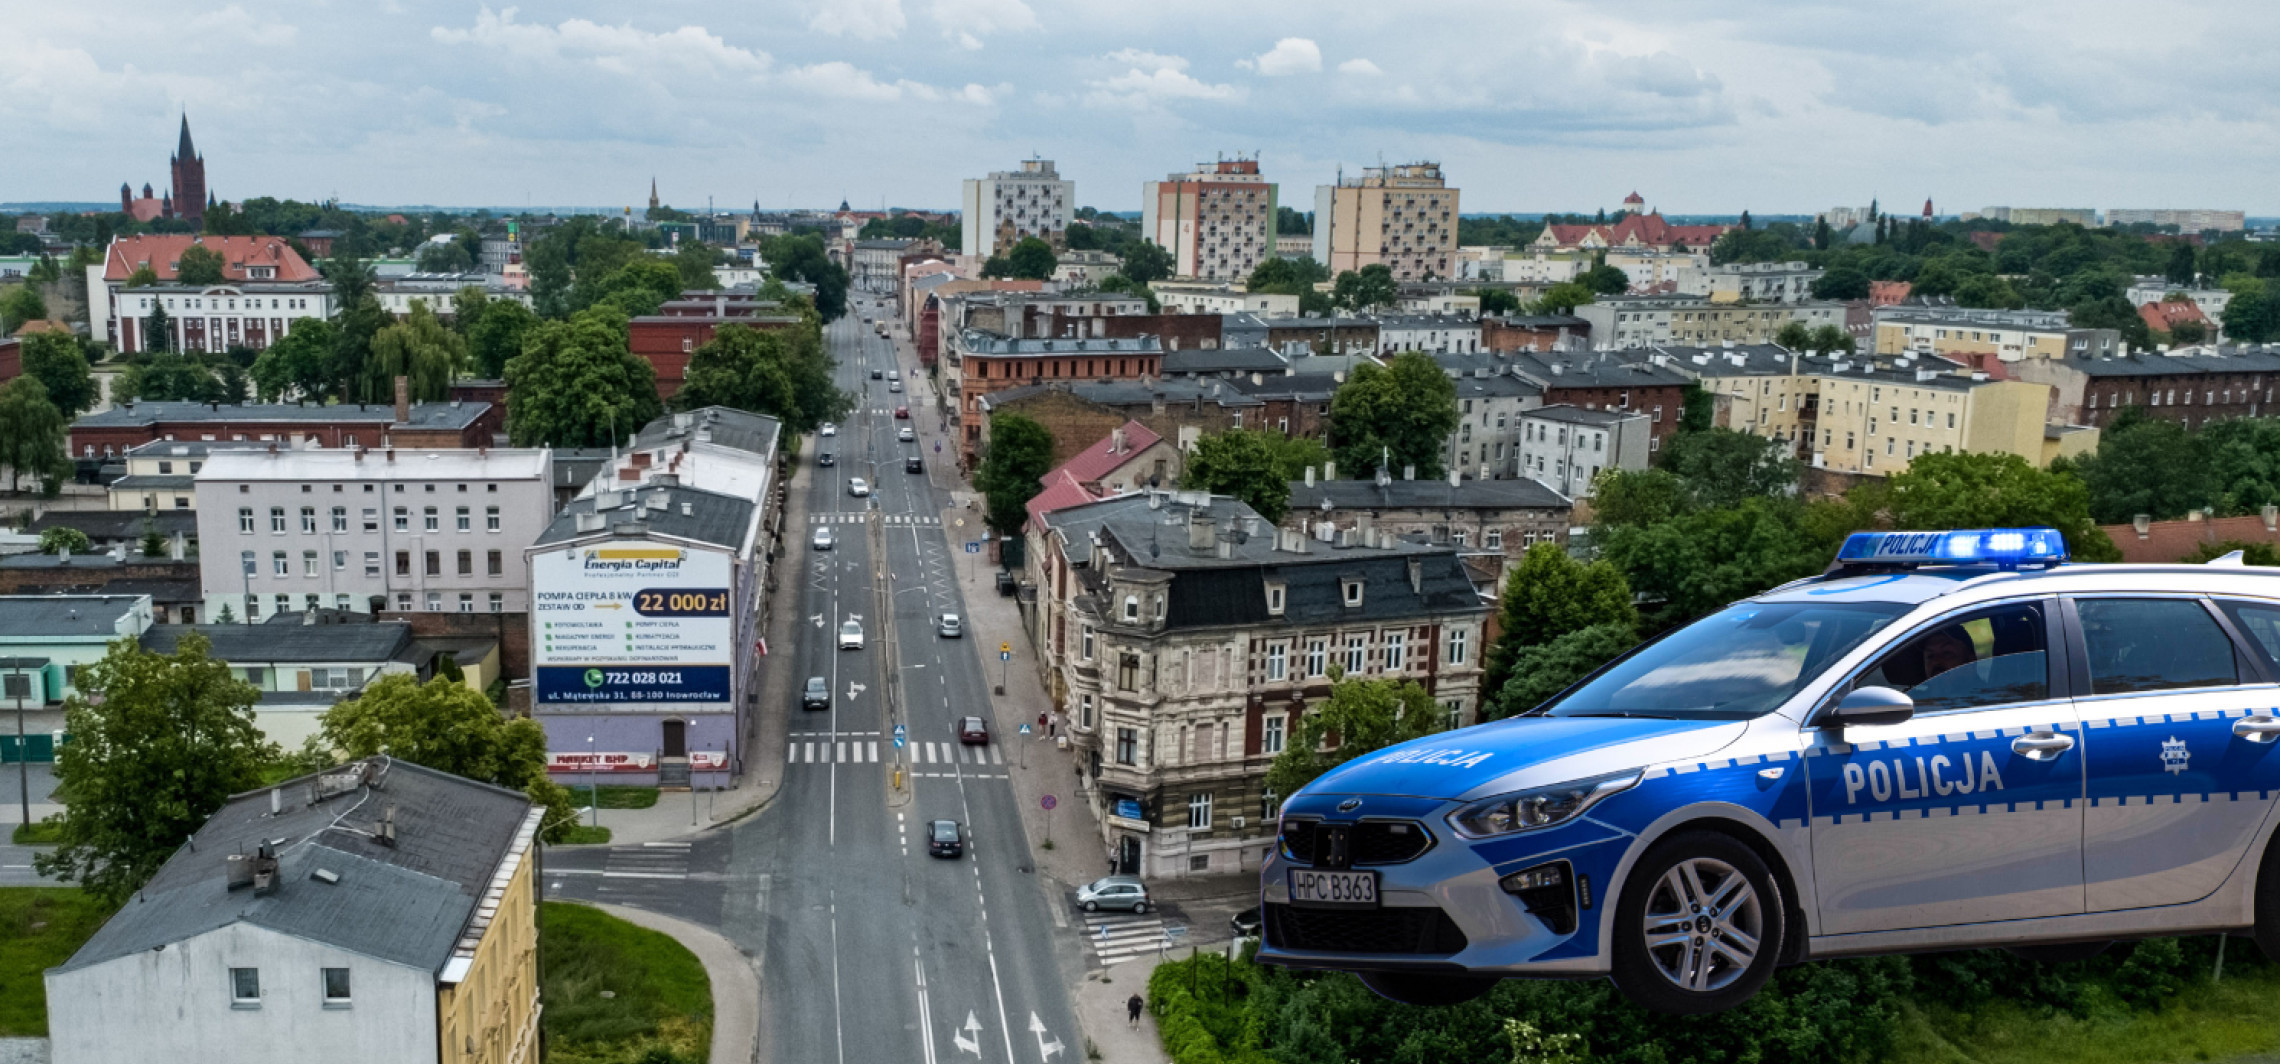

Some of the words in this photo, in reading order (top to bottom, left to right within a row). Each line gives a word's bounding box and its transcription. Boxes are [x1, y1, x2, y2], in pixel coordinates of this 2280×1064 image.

[1879, 533, 1941, 555] POLICJA
[584, 558, 632, 571] Energia
[635, 558, 681, 571] Capital
[537, 592, 573, 600] POMPA
[575, 592, 607, 600] CIEPŁA
[609, 592, 615, 600] 8
[617, 592, 633, 600] kW
[640, 593, 664, 611] 22
[669, 593, 707, 611] 000
[709, 592, 727, 611] zł
[538, 603, 571, 611] ZESTAW
[572, 603, 585, 611] OD
[605, 672, 630, 685] 722
[632, 672, 656, 685] 028
[659, 672, 683, 685] 021
[548, 691, 560, 700] ul.
[613, 691, 628, 701] 31,
[631, 691, 664, 700] 88-100
[666, 691, 721, 700] Inowrocław
[556, 755, 601, 764] MARKET
[604, 755, 629, 764] BHP
[1843, 750, 2003, 804] POLICJA
[1295, 872, 1327, 900] HPC
[1331, 874, 1373, 900] B363
